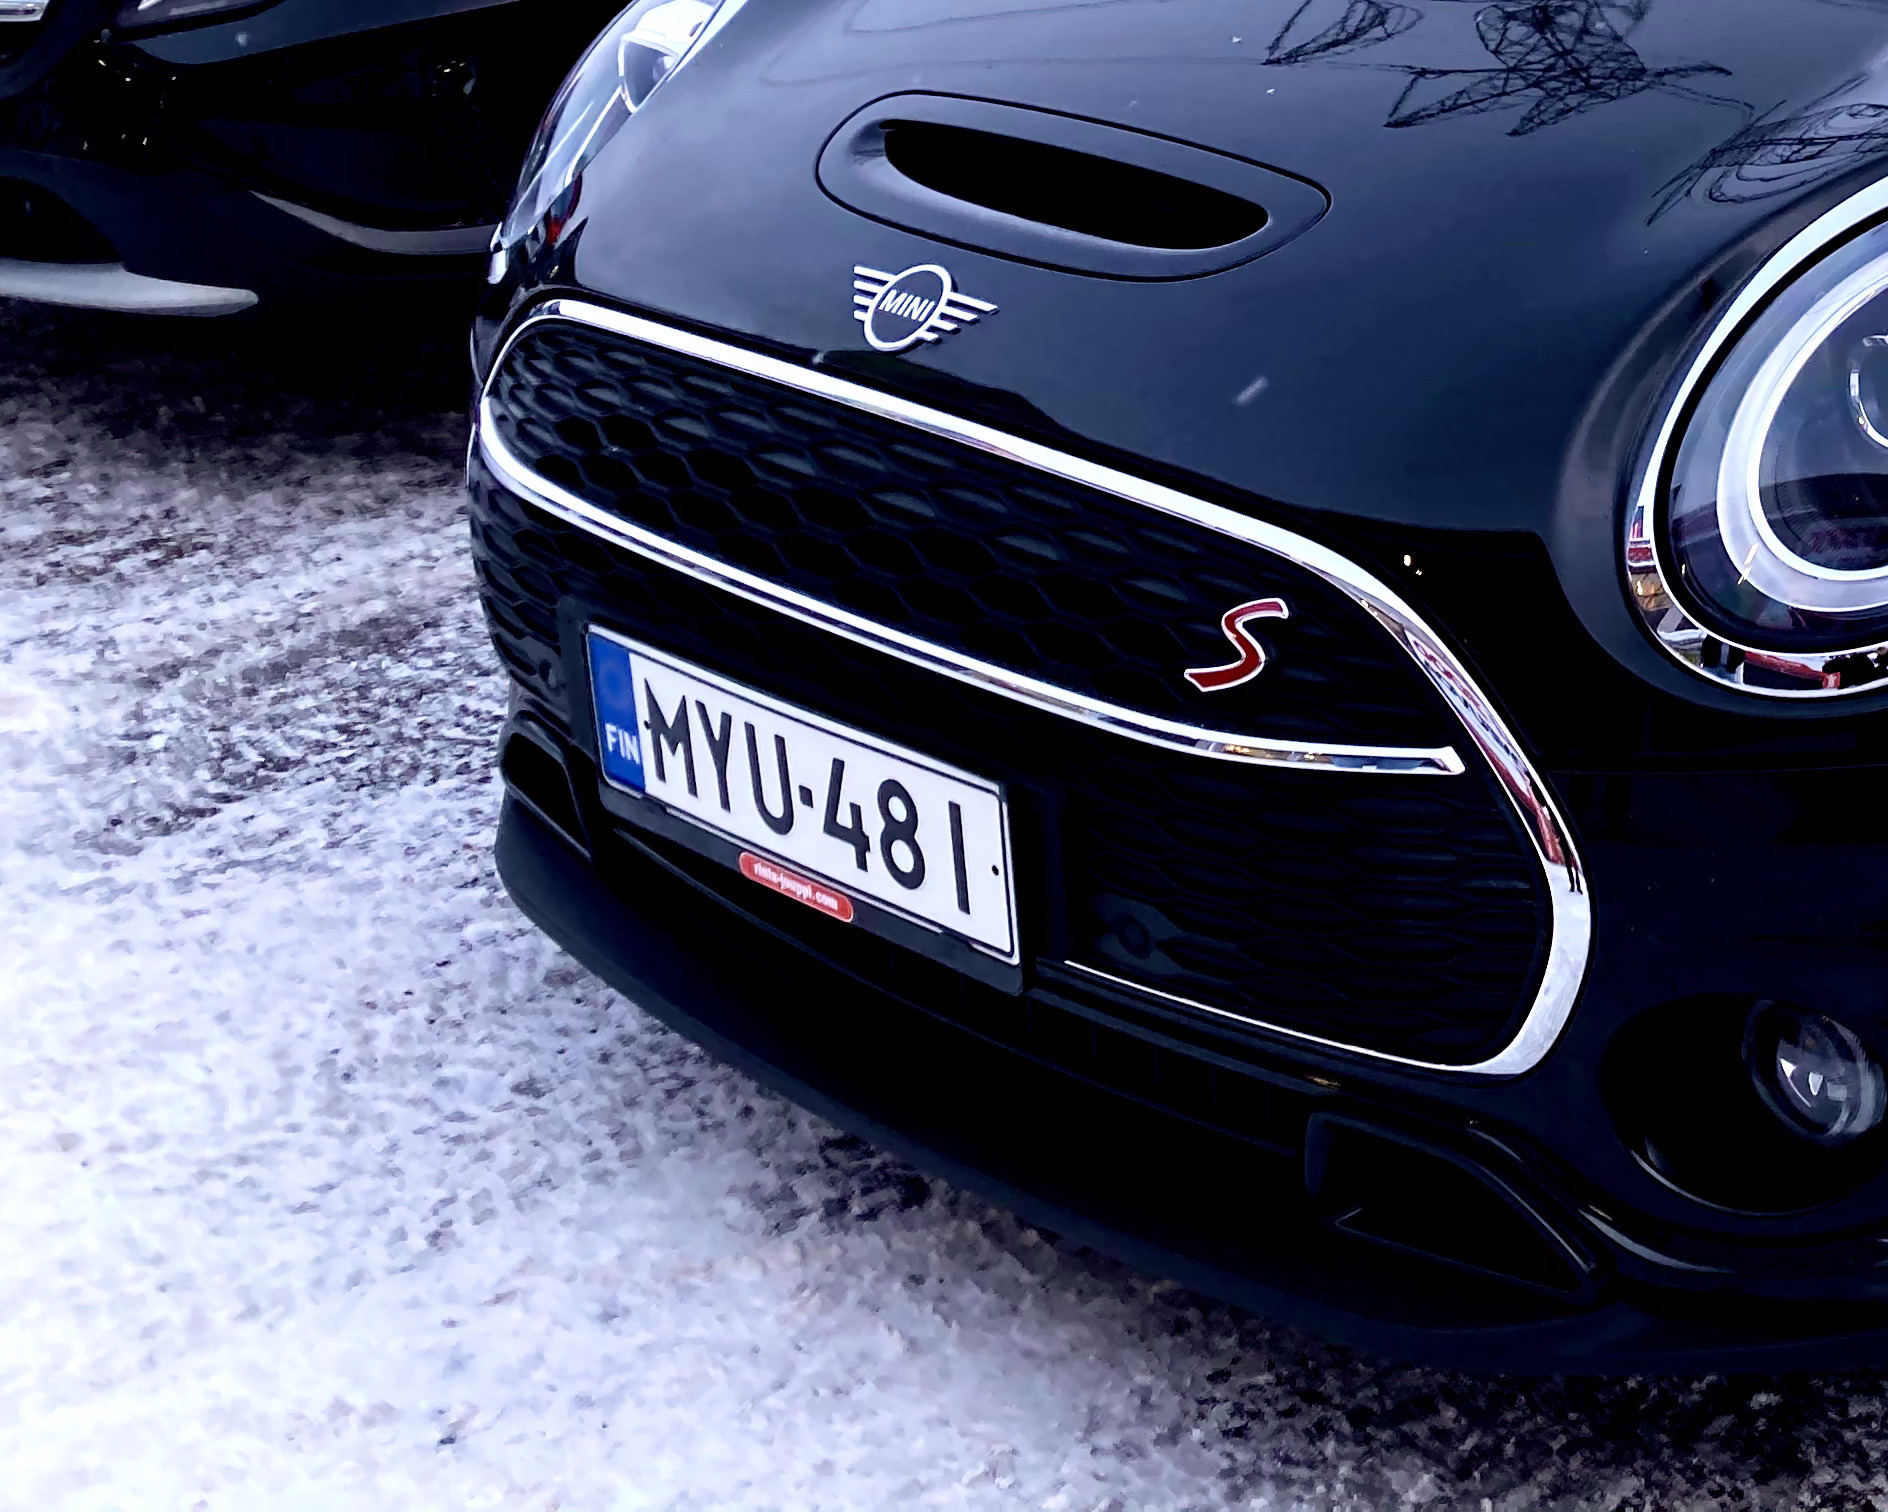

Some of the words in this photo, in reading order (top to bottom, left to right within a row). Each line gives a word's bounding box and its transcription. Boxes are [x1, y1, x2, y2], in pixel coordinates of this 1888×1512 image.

[879, 289, 936, 322] MINI
[1184, 598, 1289, 692] S
[605, 723, 640, 764] FIN
[644, 678, 970, 915] MYU-481
